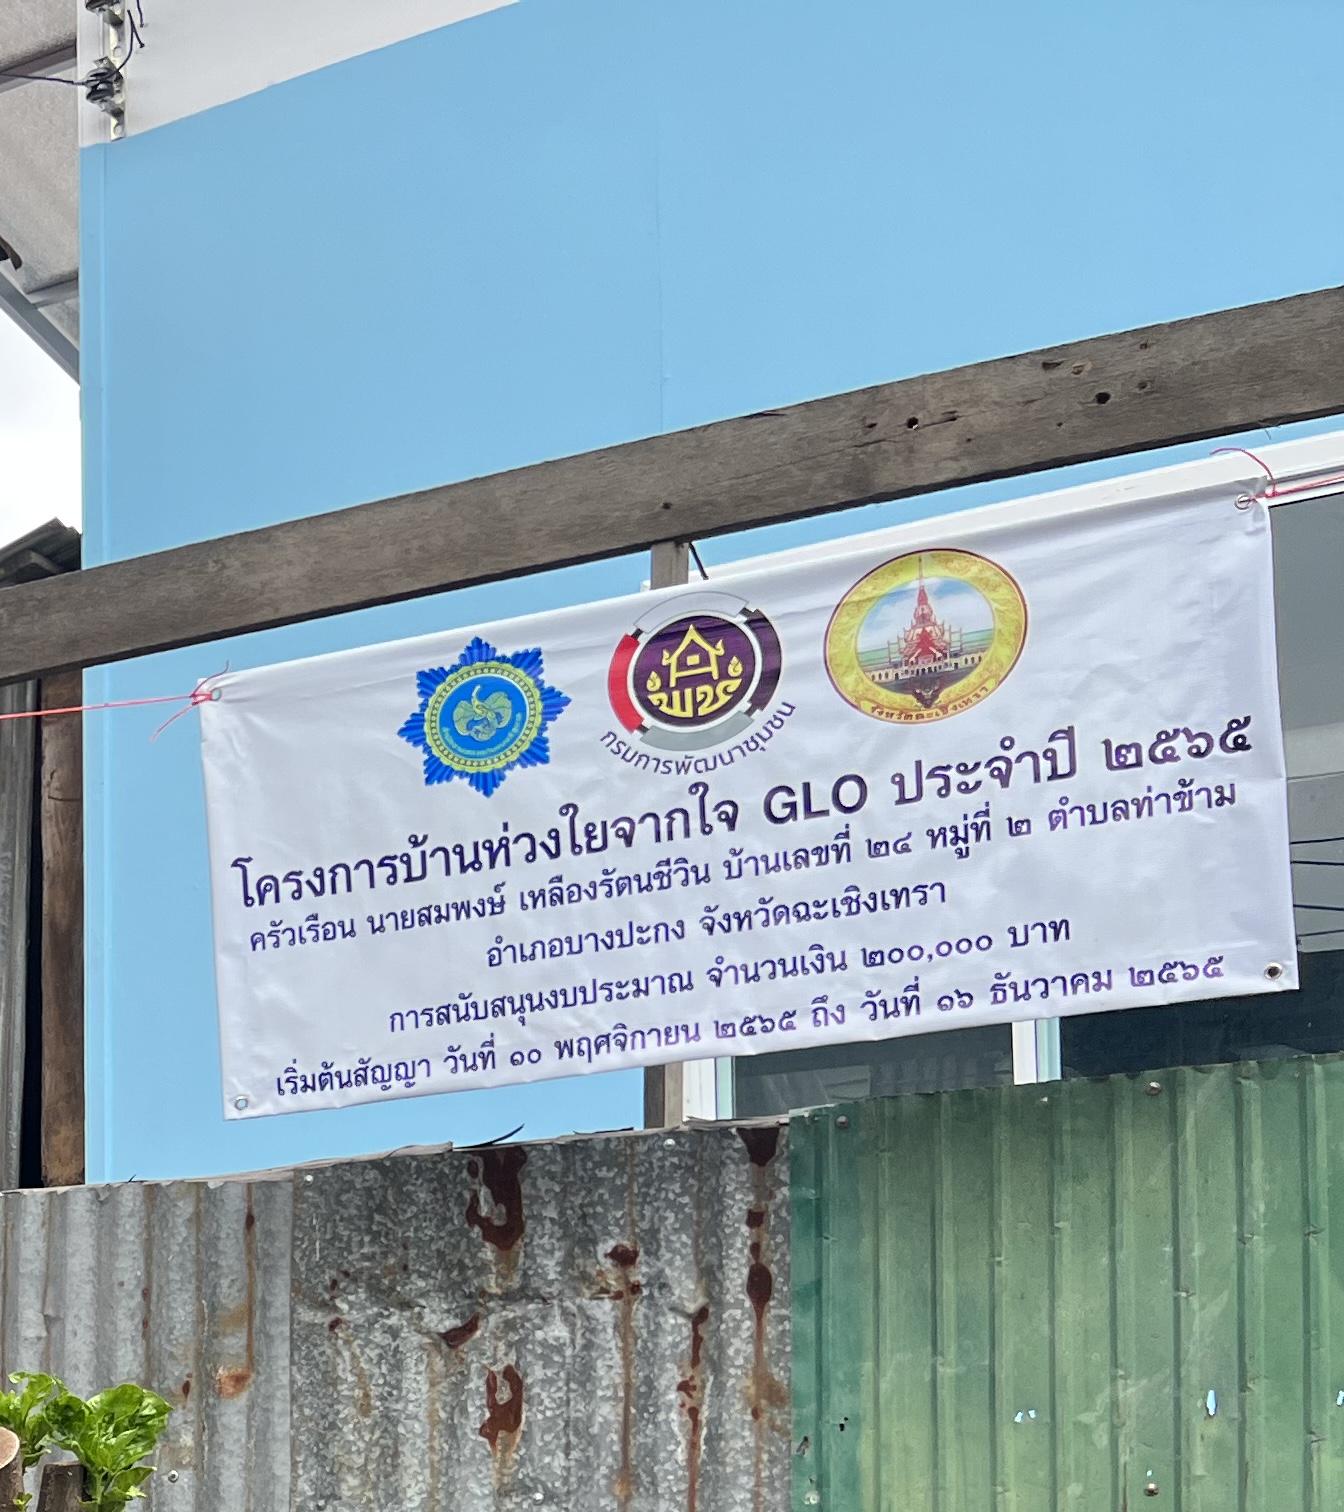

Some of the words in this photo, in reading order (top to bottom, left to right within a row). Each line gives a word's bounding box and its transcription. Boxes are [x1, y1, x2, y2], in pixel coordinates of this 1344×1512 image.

[599, 700, 797, 776] กรมการพัฒนาชุมชน
[231, 781, 740, 908] โครงการบ้านห่วงใยจากใจ
[763, 773, 868, 825] GLO
[891, 725, 1078, 806] ประจำปี
[1101, 715, 1253, 772] ๒๕๖๕
[250, 913, 357, 952] ครัวเรือน
[366, 881, 507, 936] นายสมพงษ์
[519, 857, 711, 912] เหลืองรัตนชีวิน
[723, 823, 852, 881] บ้านเลขที่
[865, 832, 913, 859] ๒๔
[926, 801, 992, 860] หมู่ที่
[1006, 815, 1032, 837] ๒
[1048, 778, 1236, 832] ตำบลท่าข้าม
[389, 969, 694, 1033] การสนับสนุนงบประมาณ
[706, 943, 848, 988] จำนวนเงิน
[861, 934, 994, 969] ๒๐๐,๐๐๐
[1008, 918, 1071, 948] บาท
[486, 918, 686, 968] อำเภอบางปะกง
[699, 881, 947, 937] จังหวัดฉะเชิงเทรา
[276, 1056, 432, 1097] เริ่มต้นสัญญา
[443, 1032, 497, 1075] วันที่
[509, 1048, 542, 1068] ๑๐
[554, 1020, 702, 1064] พฤศจิกายน
[713, 1009, 798, 1040] ๒๕๖๕
[811, 994, 847, 1029] ถึง
[860, 976, 922, 1022] วันที่
[936, 989, 974, 1013] ๑๖
[990, 968, 1114, 1007] ธันวาคม
[1128, 955, 1225, 989] ๒๕๖๕
